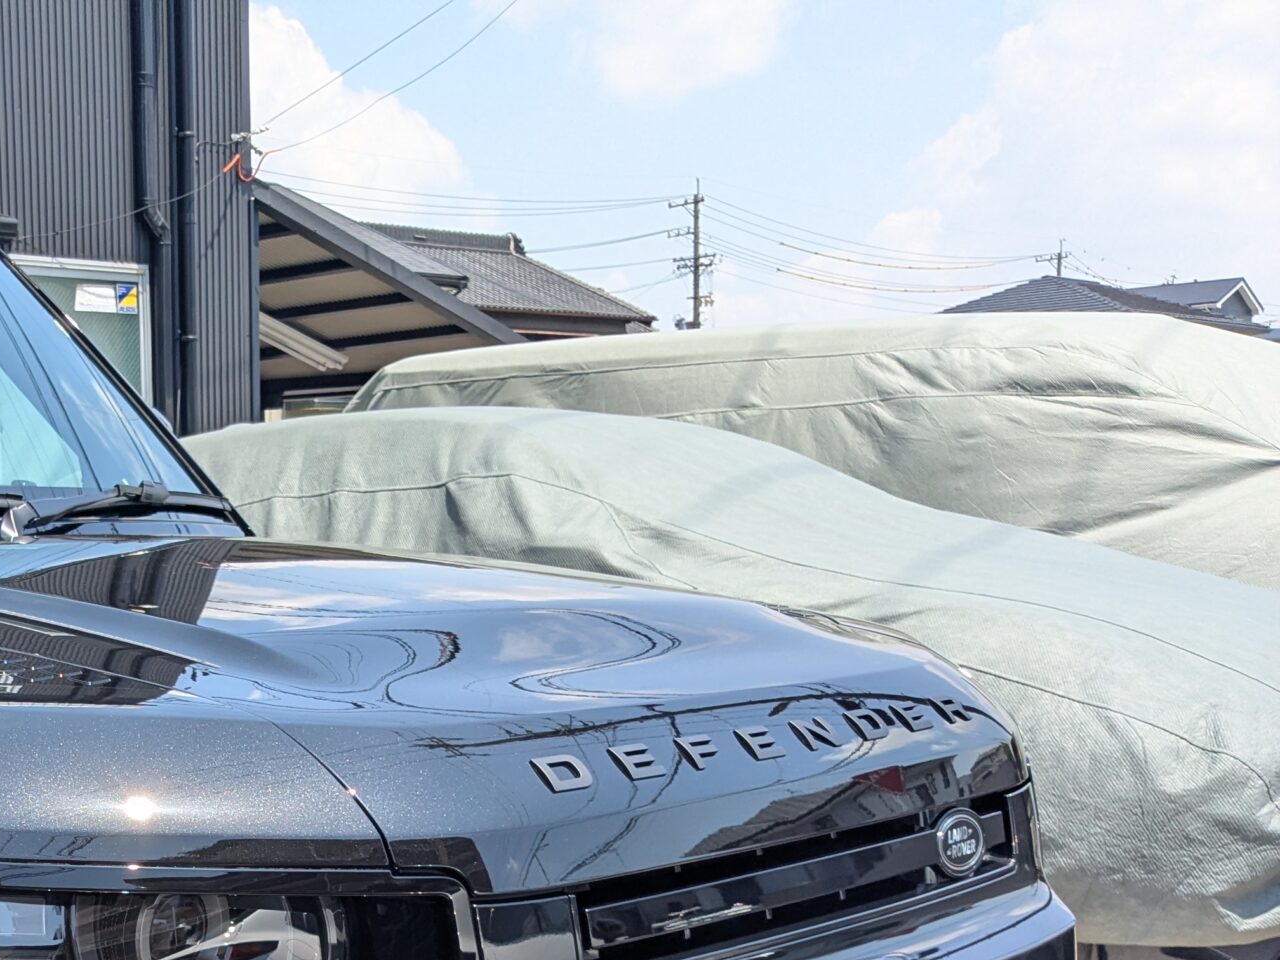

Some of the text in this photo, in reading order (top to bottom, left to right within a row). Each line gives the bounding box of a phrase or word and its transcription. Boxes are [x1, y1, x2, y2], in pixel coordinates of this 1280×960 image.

[528, 696, 972, 794] DEFENDER
[947, 825, 968, 845] LAND
[951, 838, 977, 860] ROVER
